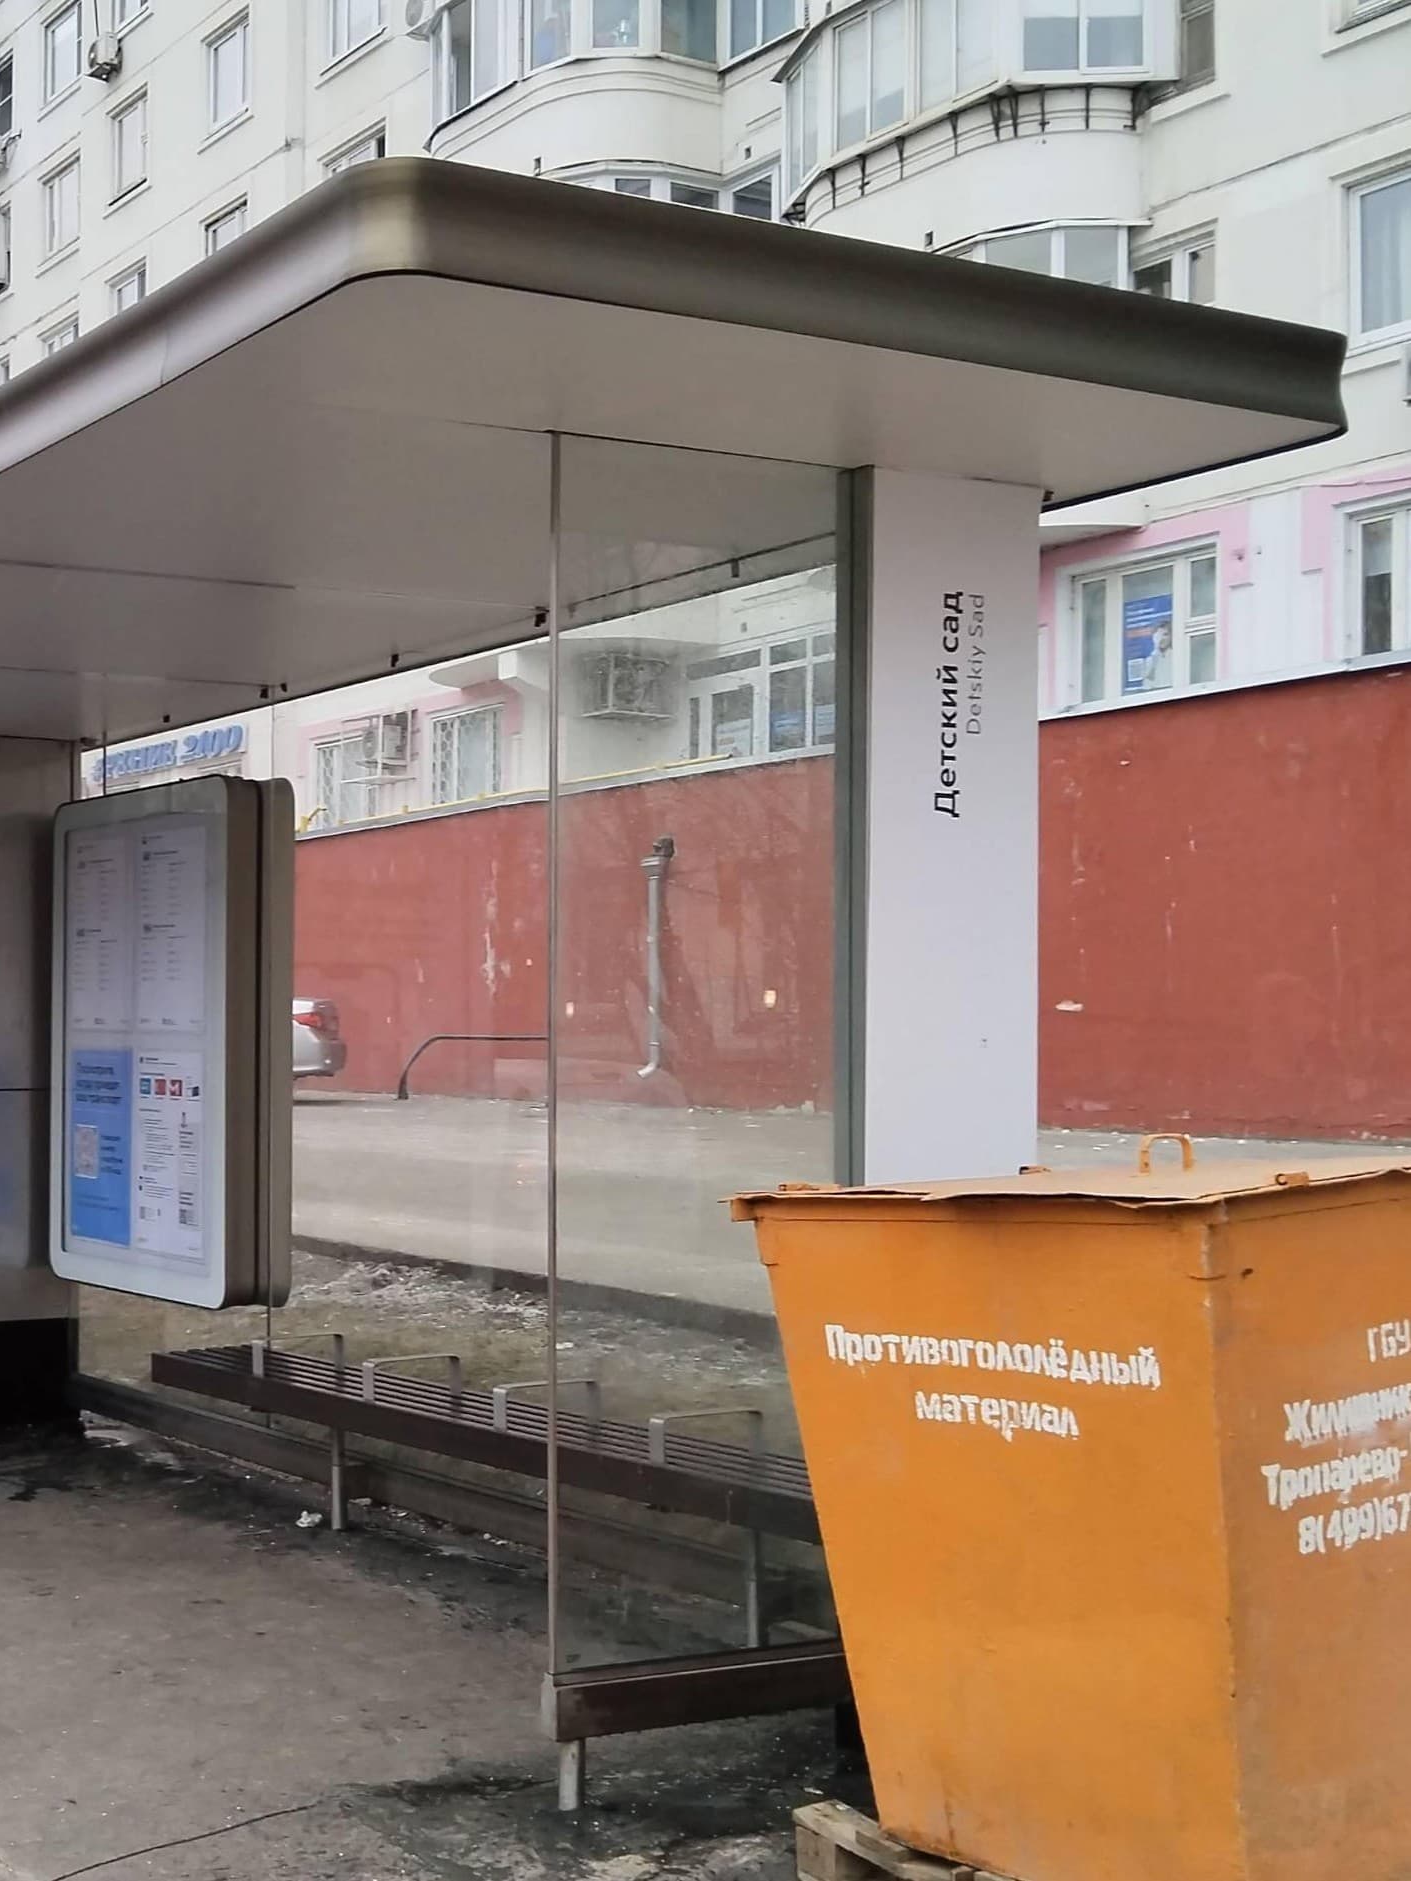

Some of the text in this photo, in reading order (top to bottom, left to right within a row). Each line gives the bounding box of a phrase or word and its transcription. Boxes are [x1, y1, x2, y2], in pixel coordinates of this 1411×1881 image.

[965, 593, 987, 735] Detskiy Sad
[933, 591, 964, 818] Детский сад
[825, 1323, 1162, 1390] Противогололёдный
[1367, 1318, 1411, 1363] ГБУ
[915, 1391, 1081, 1442] материал
